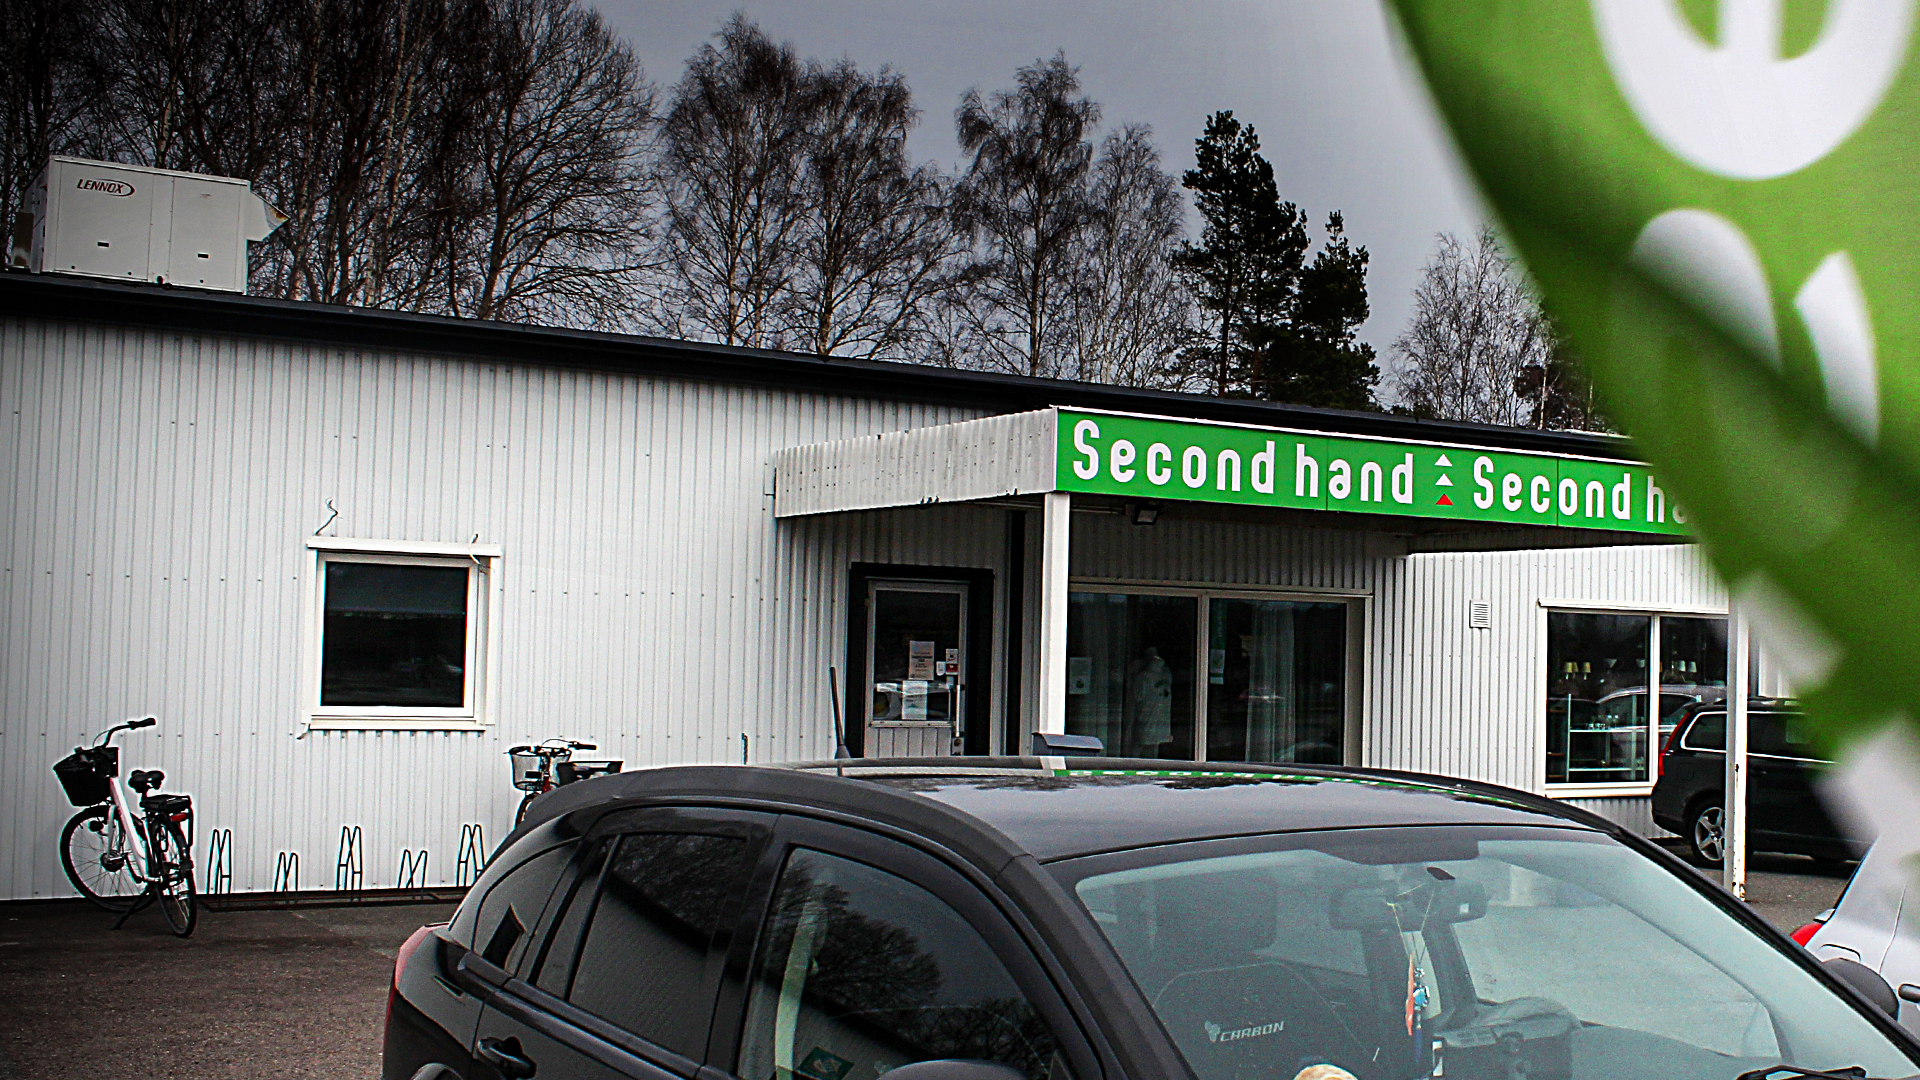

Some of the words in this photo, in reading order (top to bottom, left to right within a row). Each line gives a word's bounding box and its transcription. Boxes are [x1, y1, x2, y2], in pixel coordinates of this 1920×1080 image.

[77, 179, 124, 193] LENNOX
[1073, 419, 1275, 494] Second
[1296, 443, 1413, 505] hand
[1473, 455, 1631, 521] Second
[1220, 1021, 1284, 1041] CARBON
